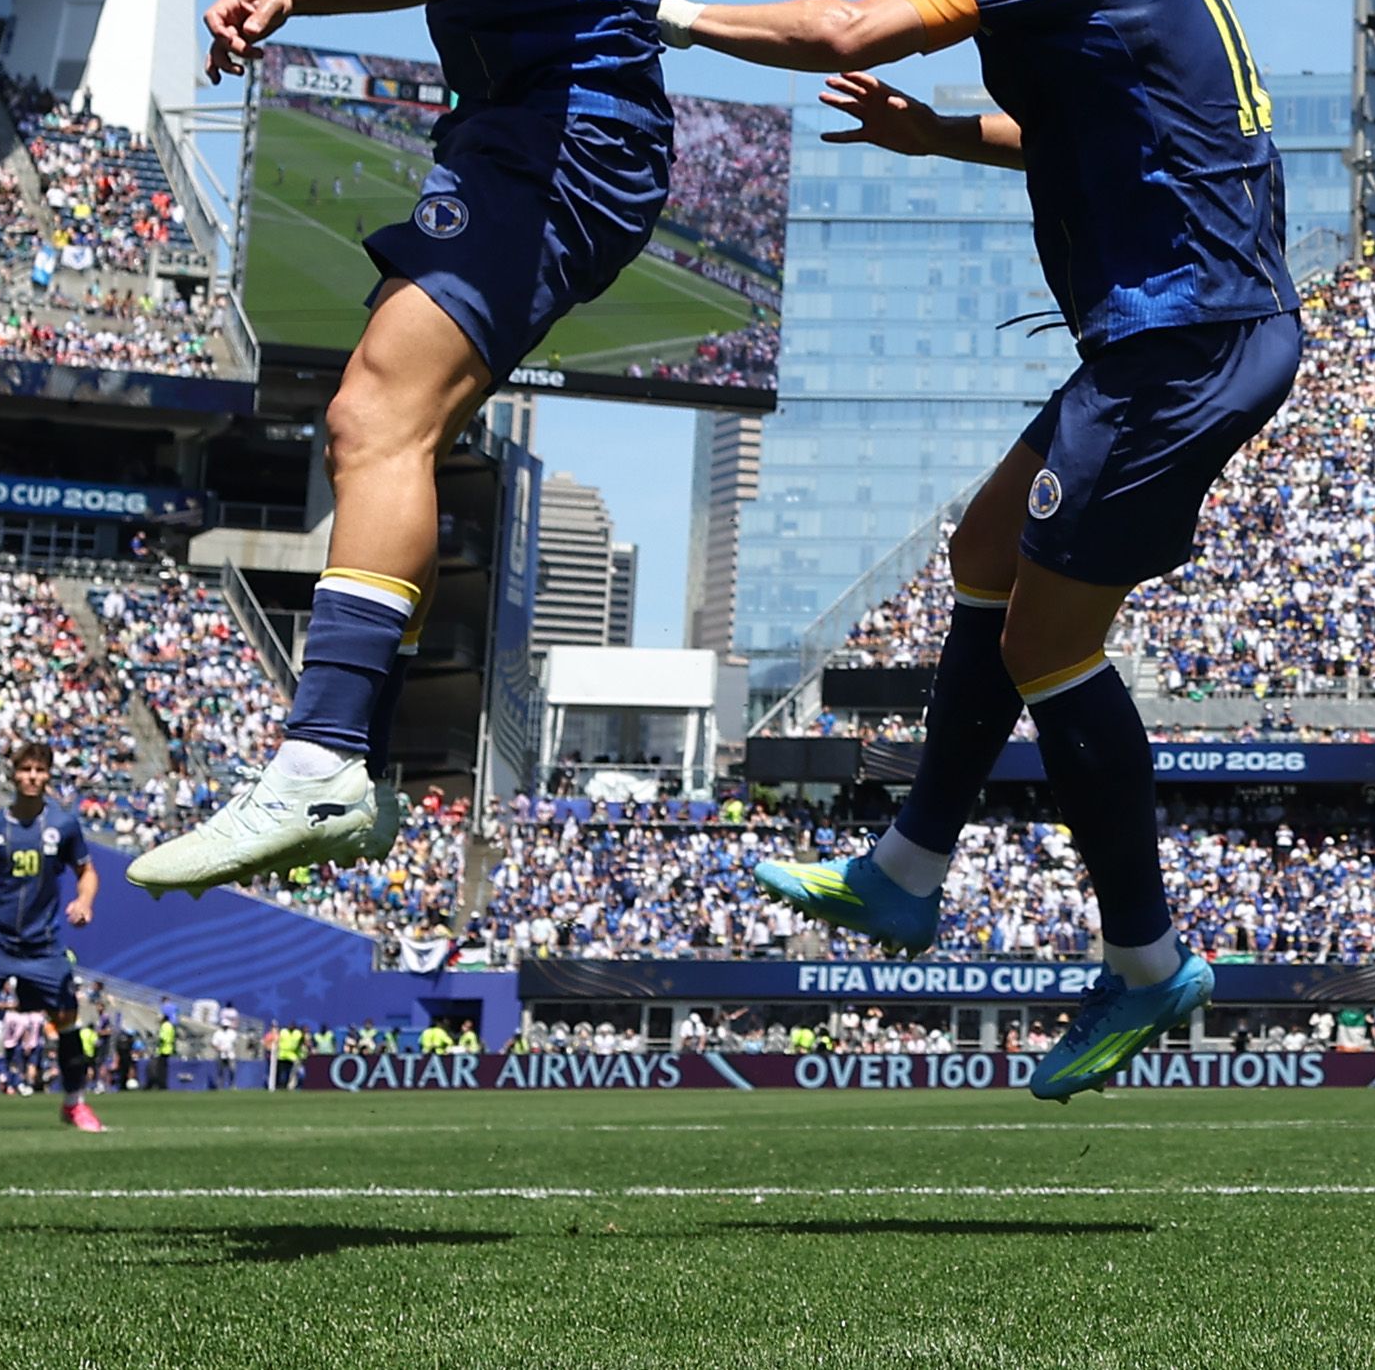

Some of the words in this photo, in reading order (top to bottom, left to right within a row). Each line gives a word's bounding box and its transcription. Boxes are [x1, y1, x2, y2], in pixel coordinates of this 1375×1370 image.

[296, 70, 353, 93] 32:52
[508, 366, 566, 388] ense
[11, 482, 62, 509] CUP
[62, 487, 148, 515] 2026
[1177, 751, 1224, 771] CUP
[1225, 751, 1306, 772] 2026
[12, 849, 40, 877] 20
[798, 965, 867, 993] FIFA
[875, 965, 989, 993] WORLD
[994, 966, 1056, 993] CUP
[329, 1053, 480, 1091] QATAR
[497, 1053, 682, 1089] AIRWAYS
[794, 1054, 913, 1089] OVER
[927, 1054, 995, 1088] 160
[1007, 1054, 1325, 1087] DNATIONS
